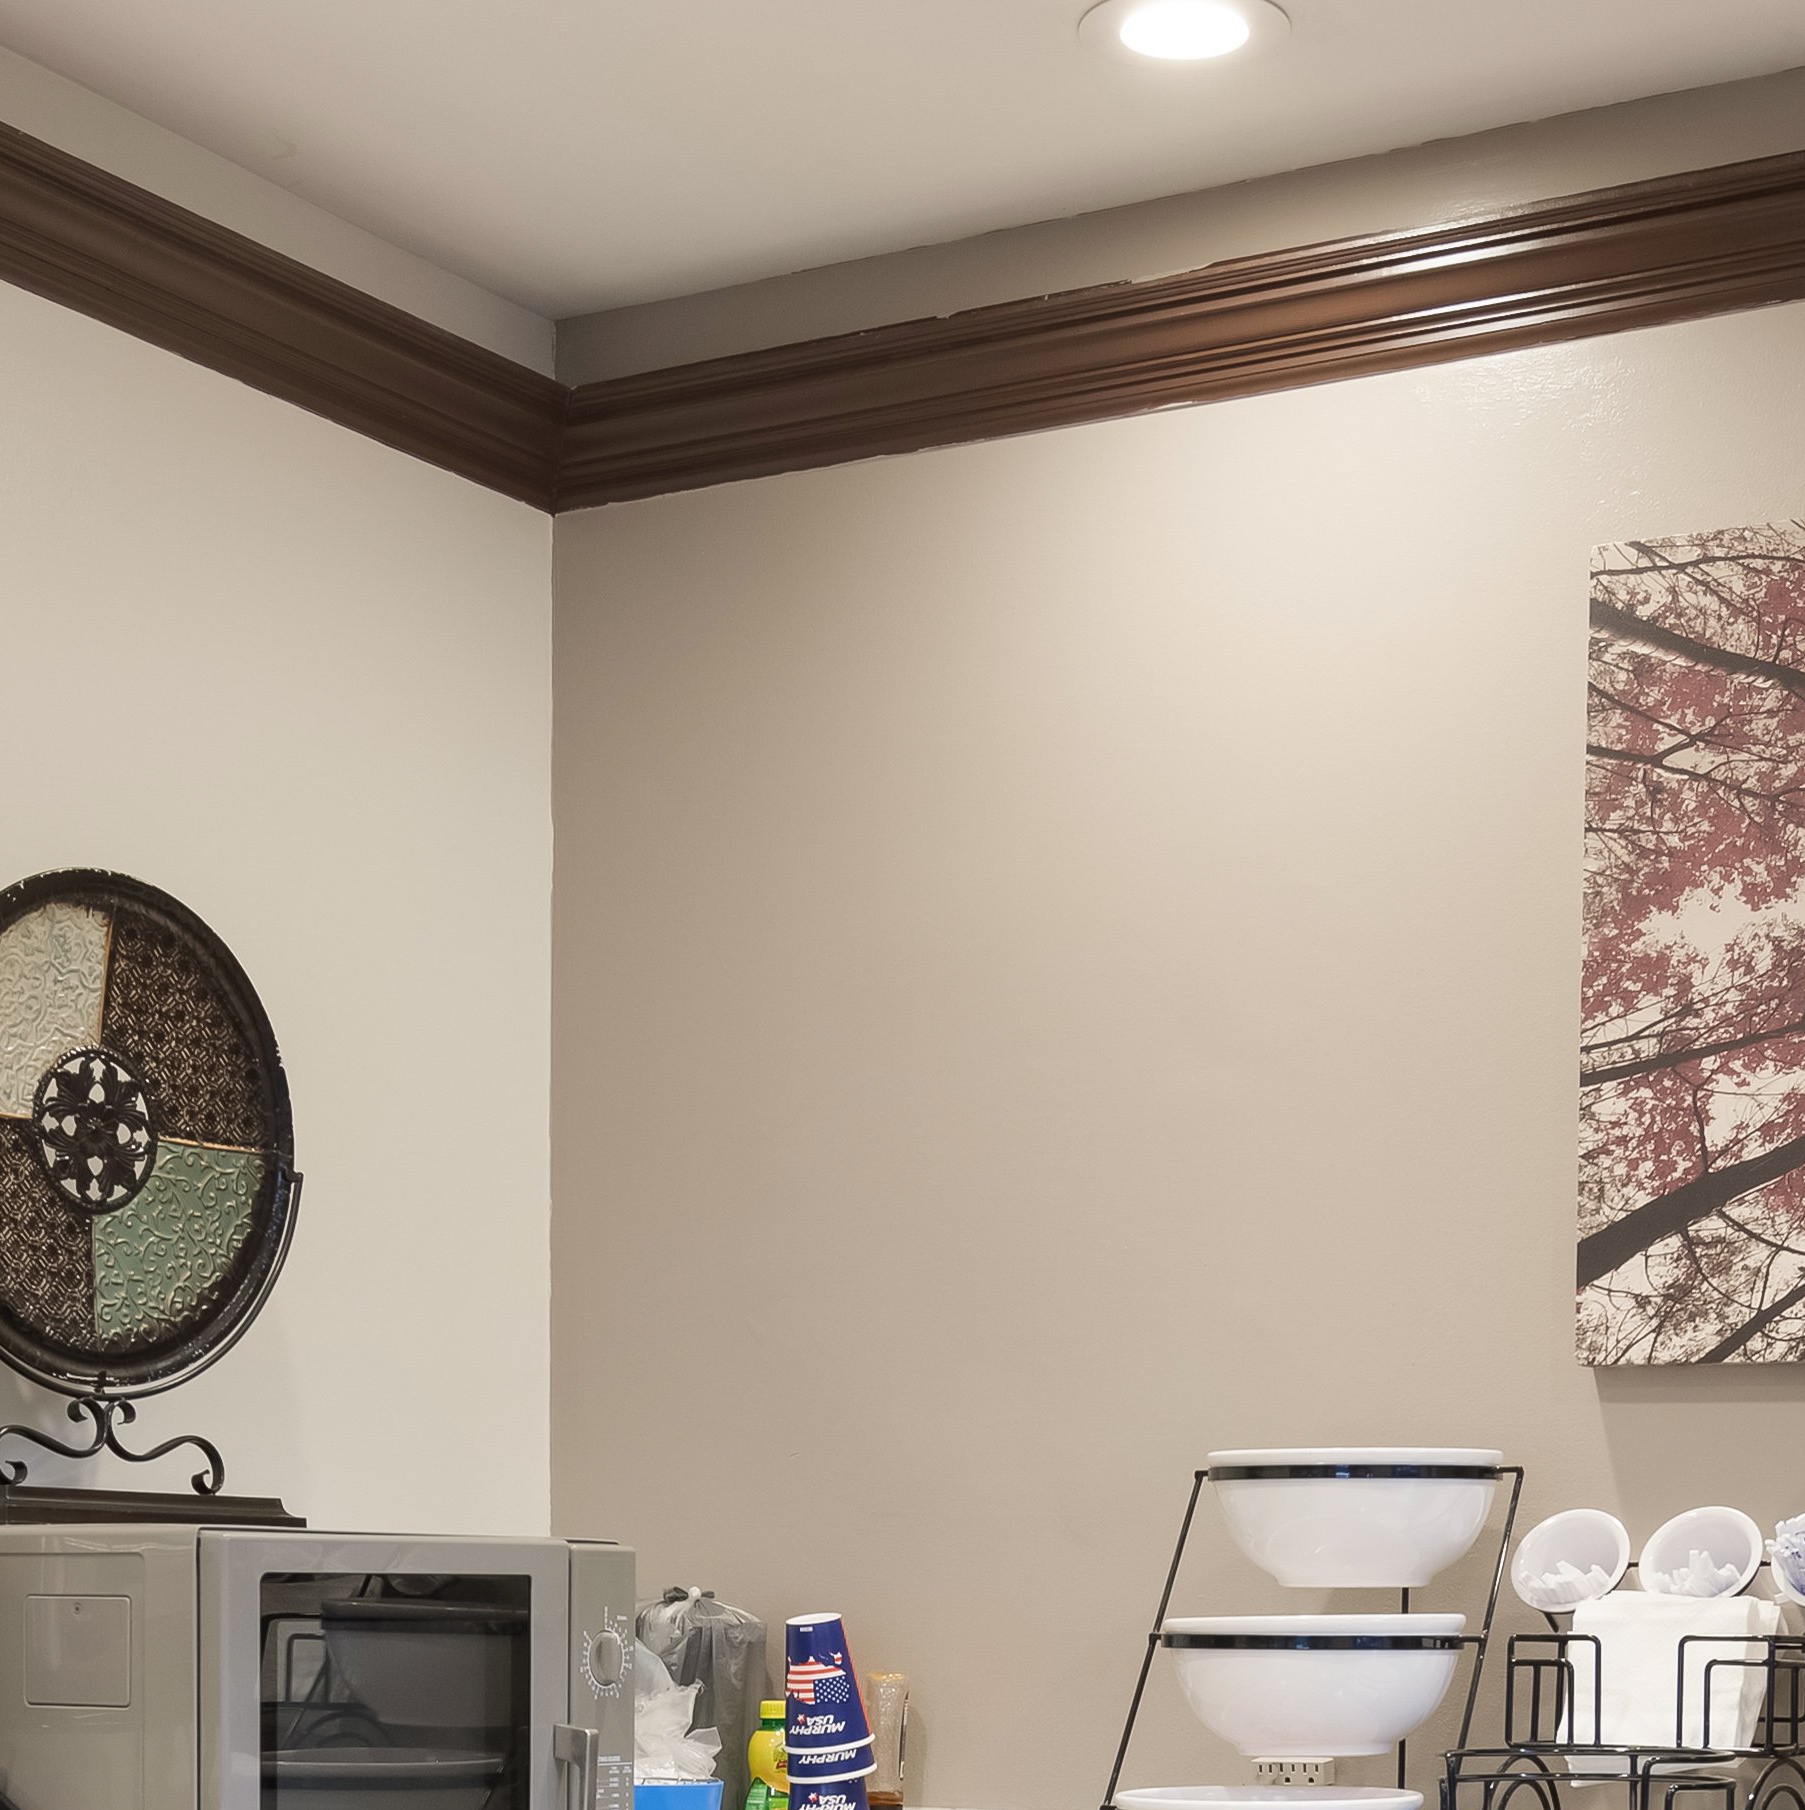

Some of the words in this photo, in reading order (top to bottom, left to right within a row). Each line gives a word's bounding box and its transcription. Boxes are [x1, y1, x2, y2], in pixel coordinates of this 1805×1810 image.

[806, 1714, 834, 1726] USA
[789, 1721, 845, 1735] MURPHY
[798, 1749, 857, 1764] MURPHY
[818, 1794, 847, 1804] USA
